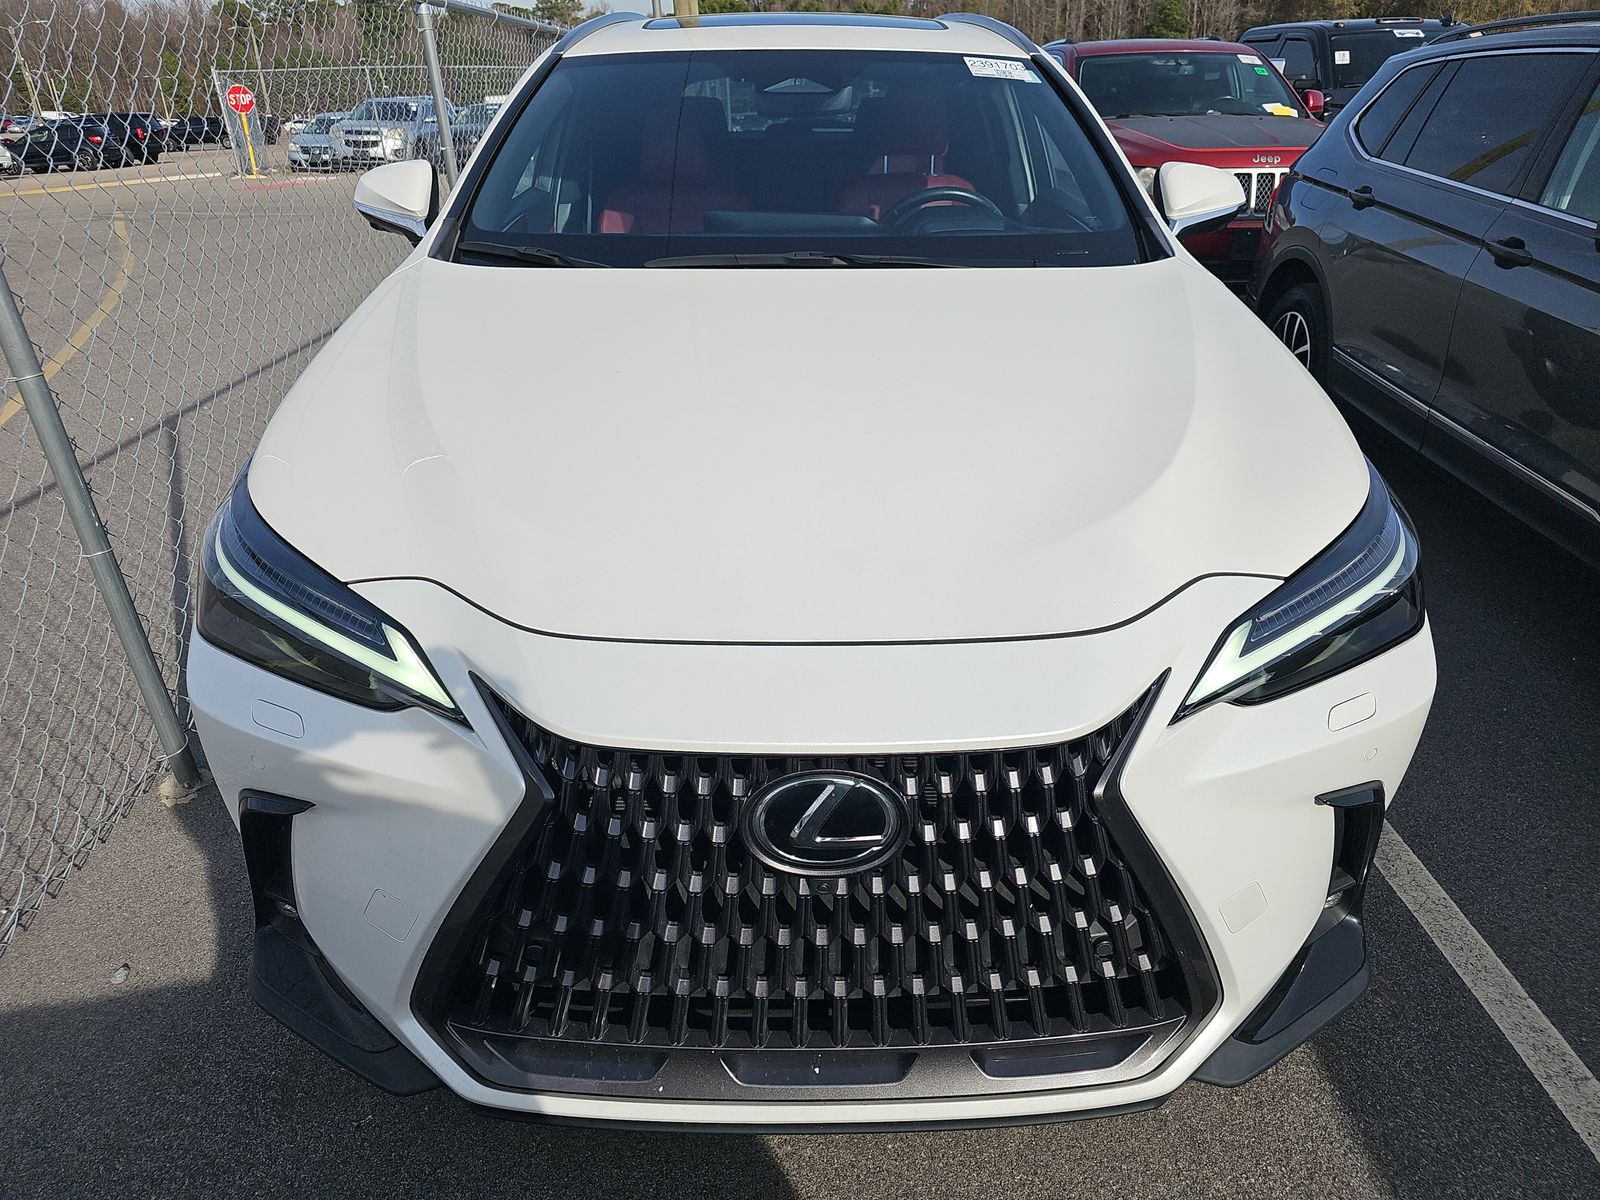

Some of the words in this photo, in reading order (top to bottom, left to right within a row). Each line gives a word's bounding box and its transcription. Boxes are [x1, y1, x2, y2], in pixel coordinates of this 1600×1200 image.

[968, 60, 1026, 71] 2391703
[229, 94, 251, 105] STOP
[1252, 154, 1281, 164] Jeep
